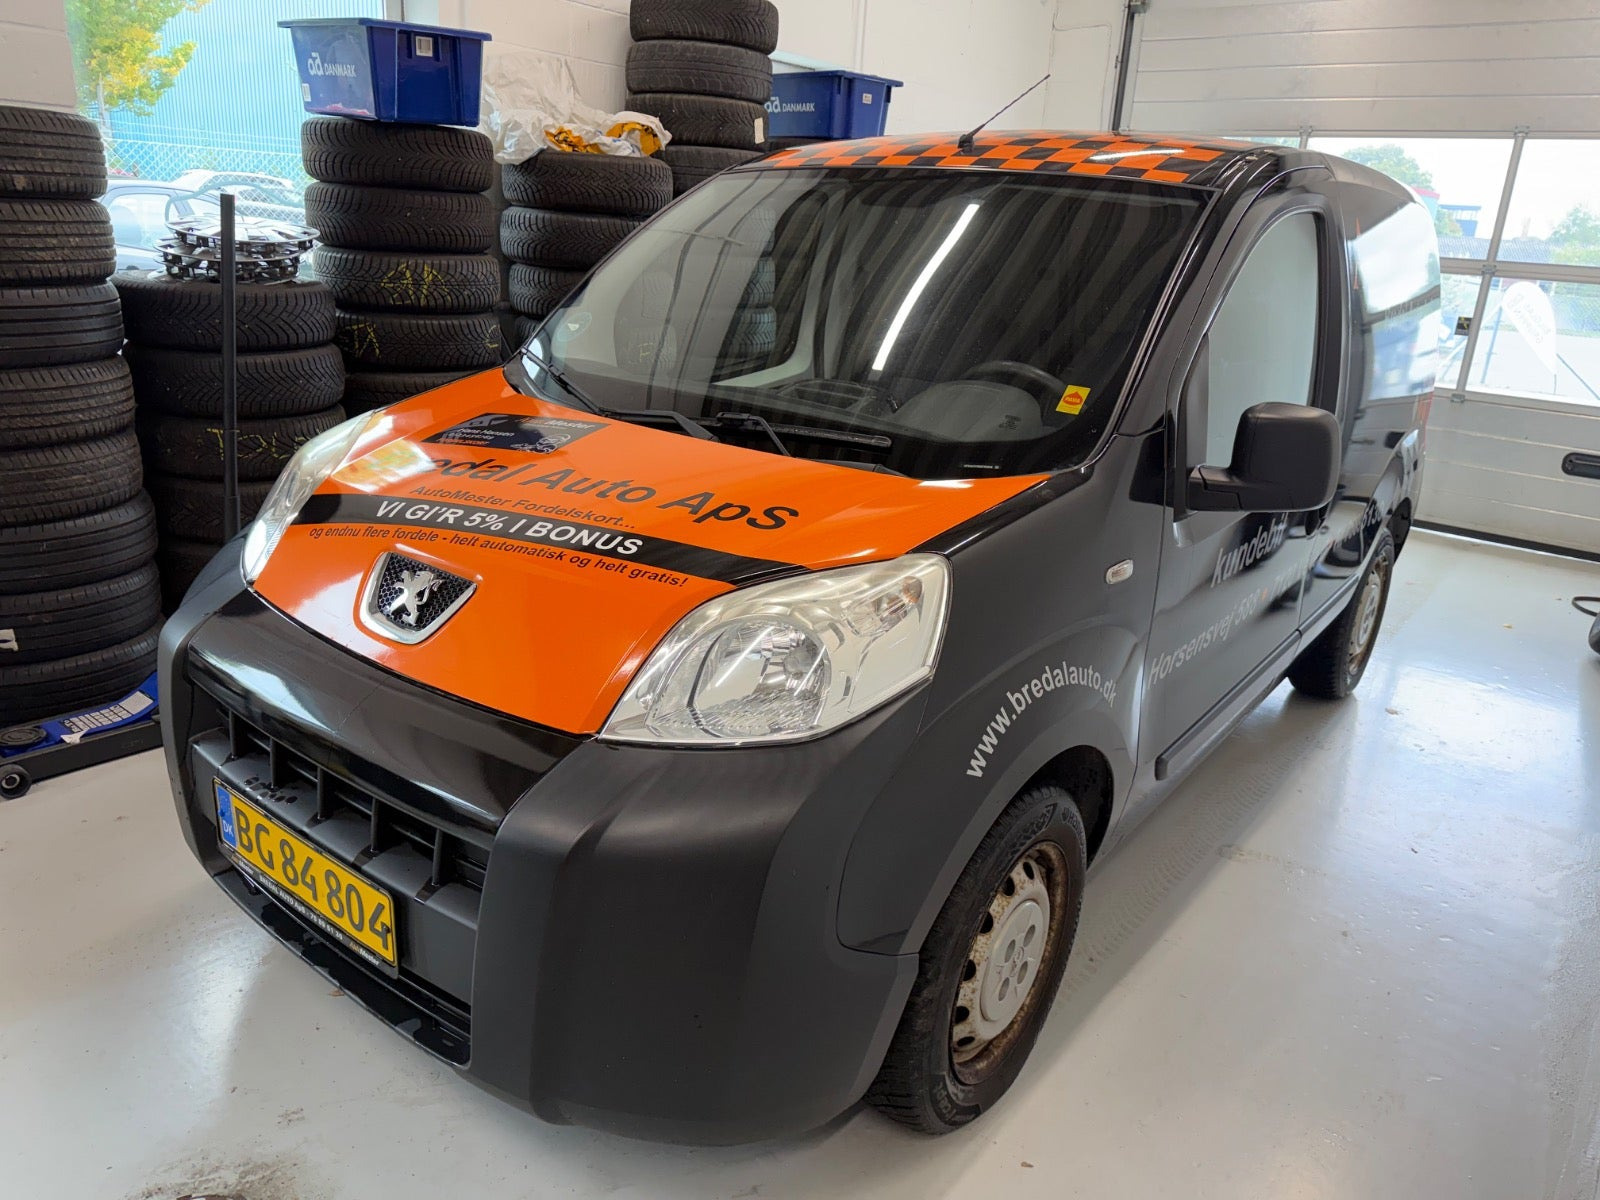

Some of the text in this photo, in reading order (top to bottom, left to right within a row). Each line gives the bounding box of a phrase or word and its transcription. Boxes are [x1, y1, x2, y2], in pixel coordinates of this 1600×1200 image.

[324, 63, 357, 77] DANMARK
[782, 102, 816, 113] DANMARK
[376, 500, 406, 518] VI
[463, 511, 509, 532] 5%
[508, 518, 527, 534] I
[525, 521, 643, 555] BONUS
[410, 486, 636, 529] AutoMester Fordelskort...
[517, 468, 657, 503] Auto
[656, 491, 800, 530] ApS
[309, 528, 324, 539] og
[325, 527, 361, 538] endnu
[362, 526, 390, 538] flere
[391, 527, 439, 543] fordele
[450, 533, 478, 548] helt
[480, 539, 568, 562] automatisk
[569, 555, 592, 569] og
[593, 558, 631, 575] helt
[628, 567, 689, 588] gratis!
[1148, 608, 1235, 688] Horsensvej
[966, 661, 1117, 778] www.bredalauto.dk
[222, 819, 234, 838] DK
[234, 805, 391, 951] BG 84 804
